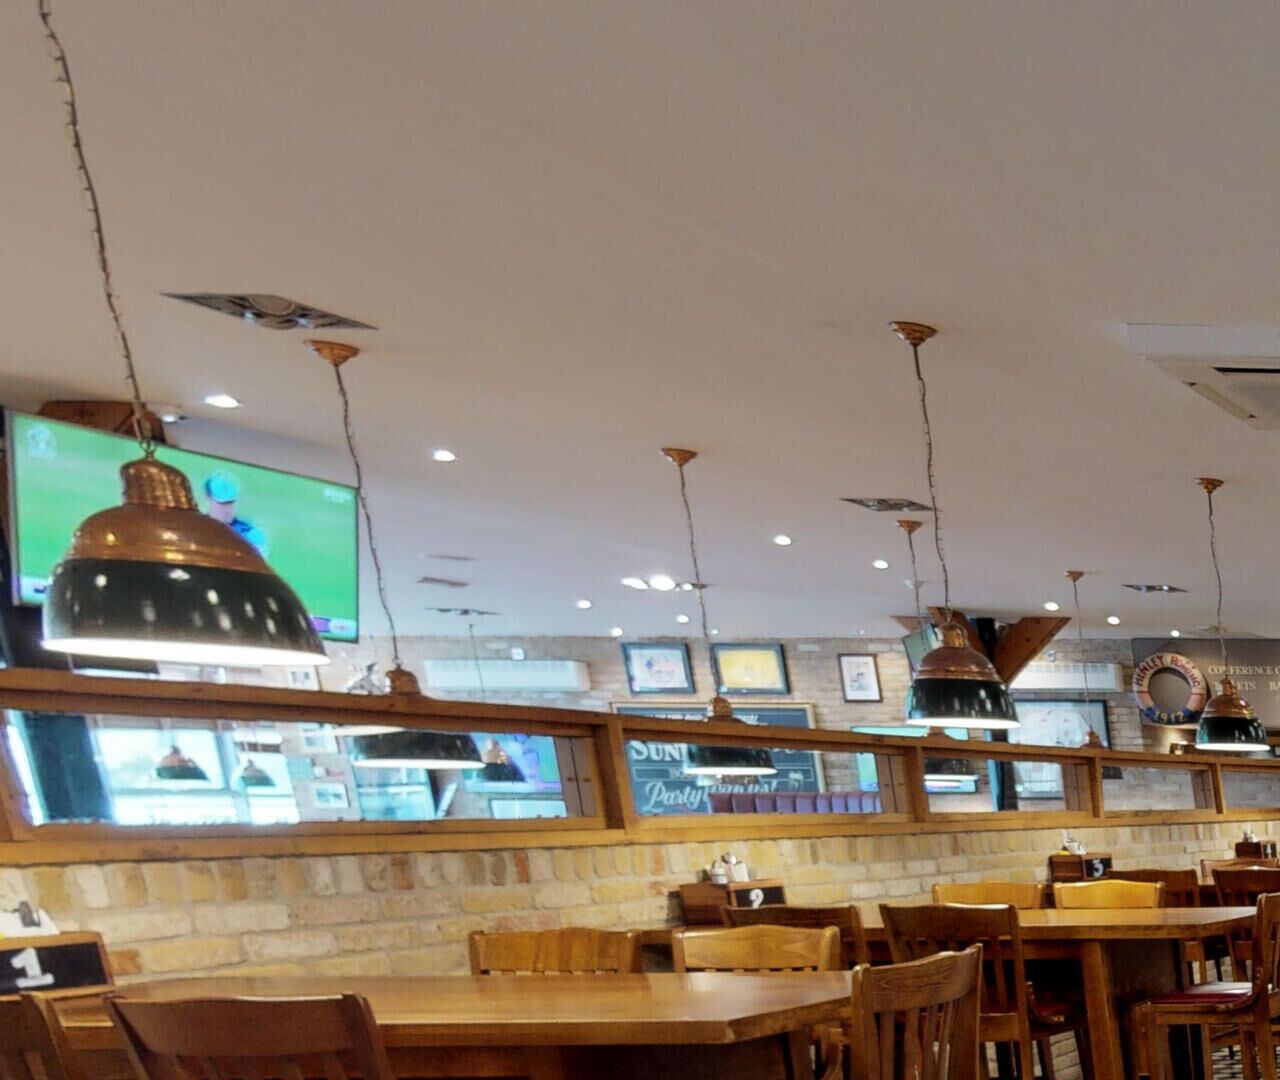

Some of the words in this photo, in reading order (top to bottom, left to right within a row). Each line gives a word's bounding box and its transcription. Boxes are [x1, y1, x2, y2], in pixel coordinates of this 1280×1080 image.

[645, 781, 704, 810] Party
[1093, 859, 1104, 878] 3
[10, 947, 55, 989] 1
